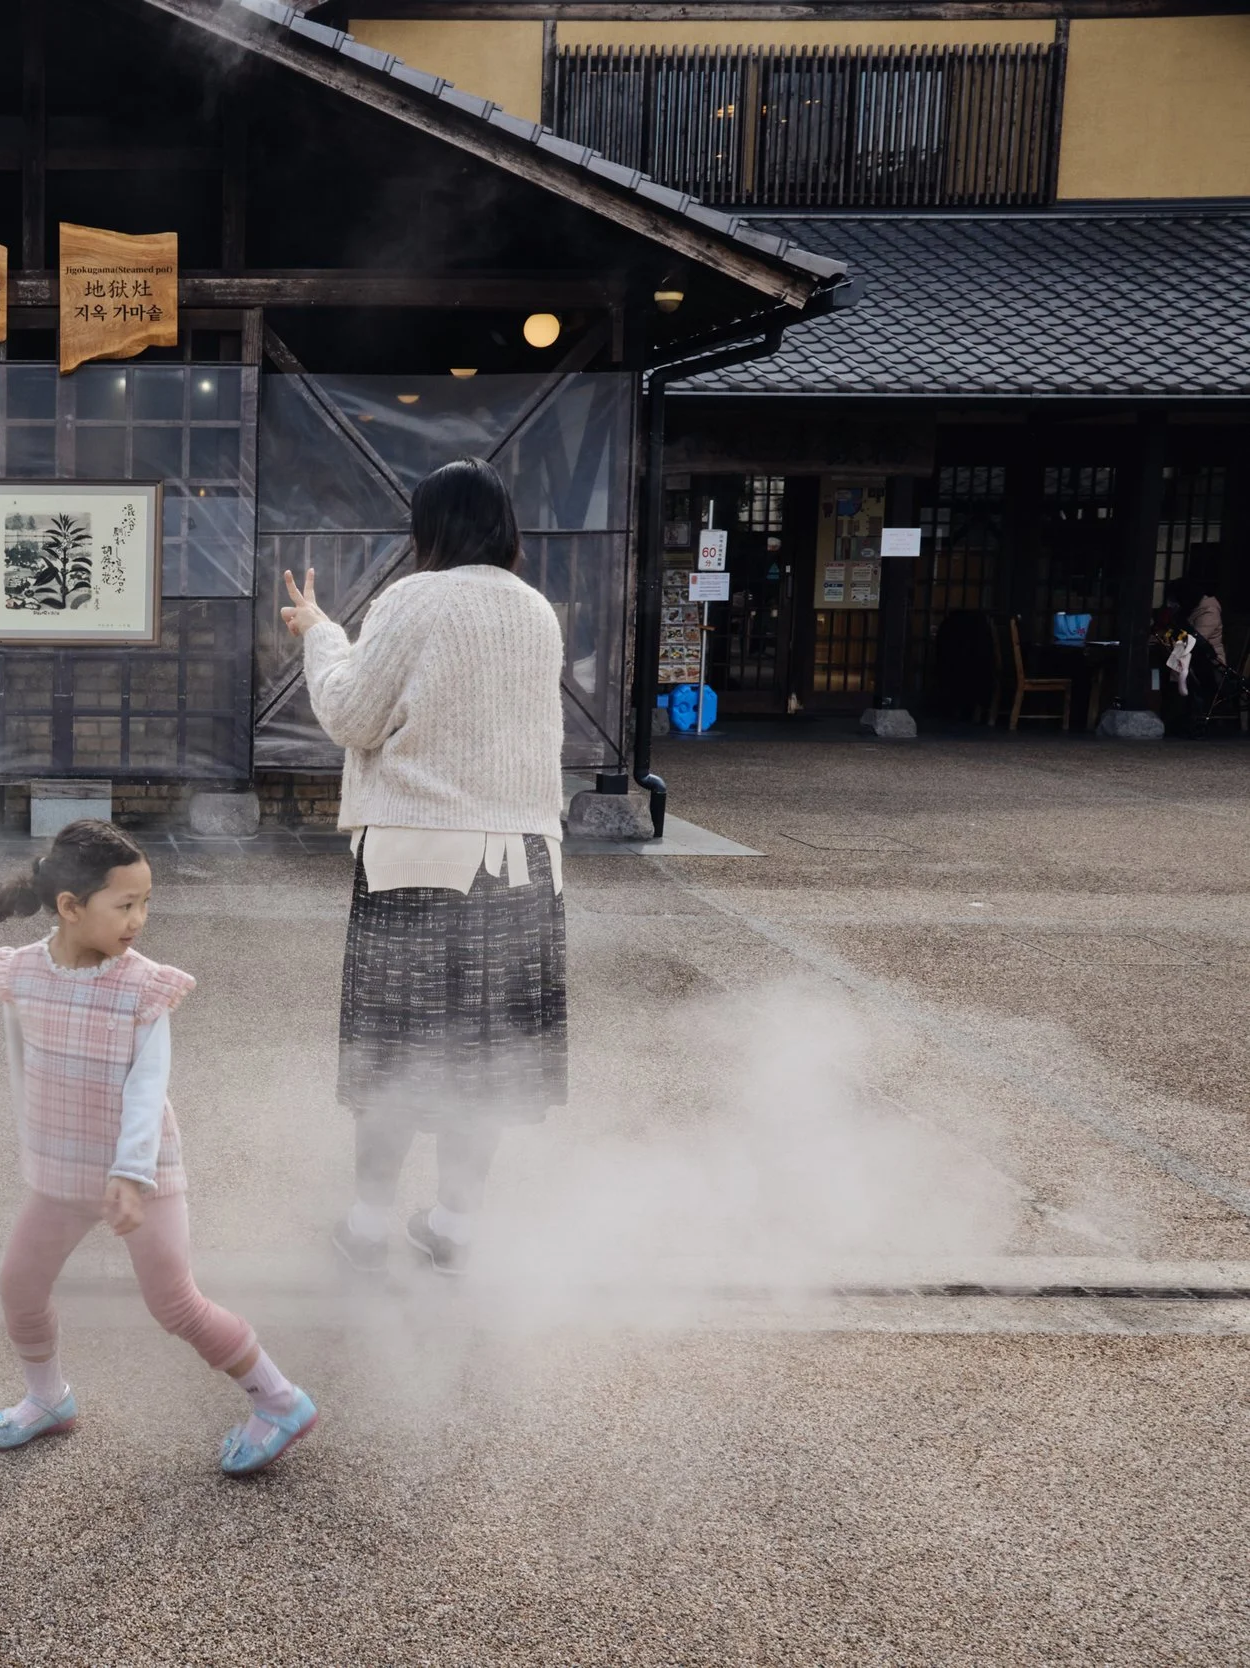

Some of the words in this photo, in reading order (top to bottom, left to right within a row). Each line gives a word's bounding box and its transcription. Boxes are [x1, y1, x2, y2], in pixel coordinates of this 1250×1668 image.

[65, 266, 154, 275] Jigokugama(Steamed
[155, 266, 173, 275] pot)
[84, 279, 153, 298] 地狱灶
[74, 304, 108, 322] 지옥
[113, 304, 163, 322] 가마솥
[702, 547, 717, 558] 60
